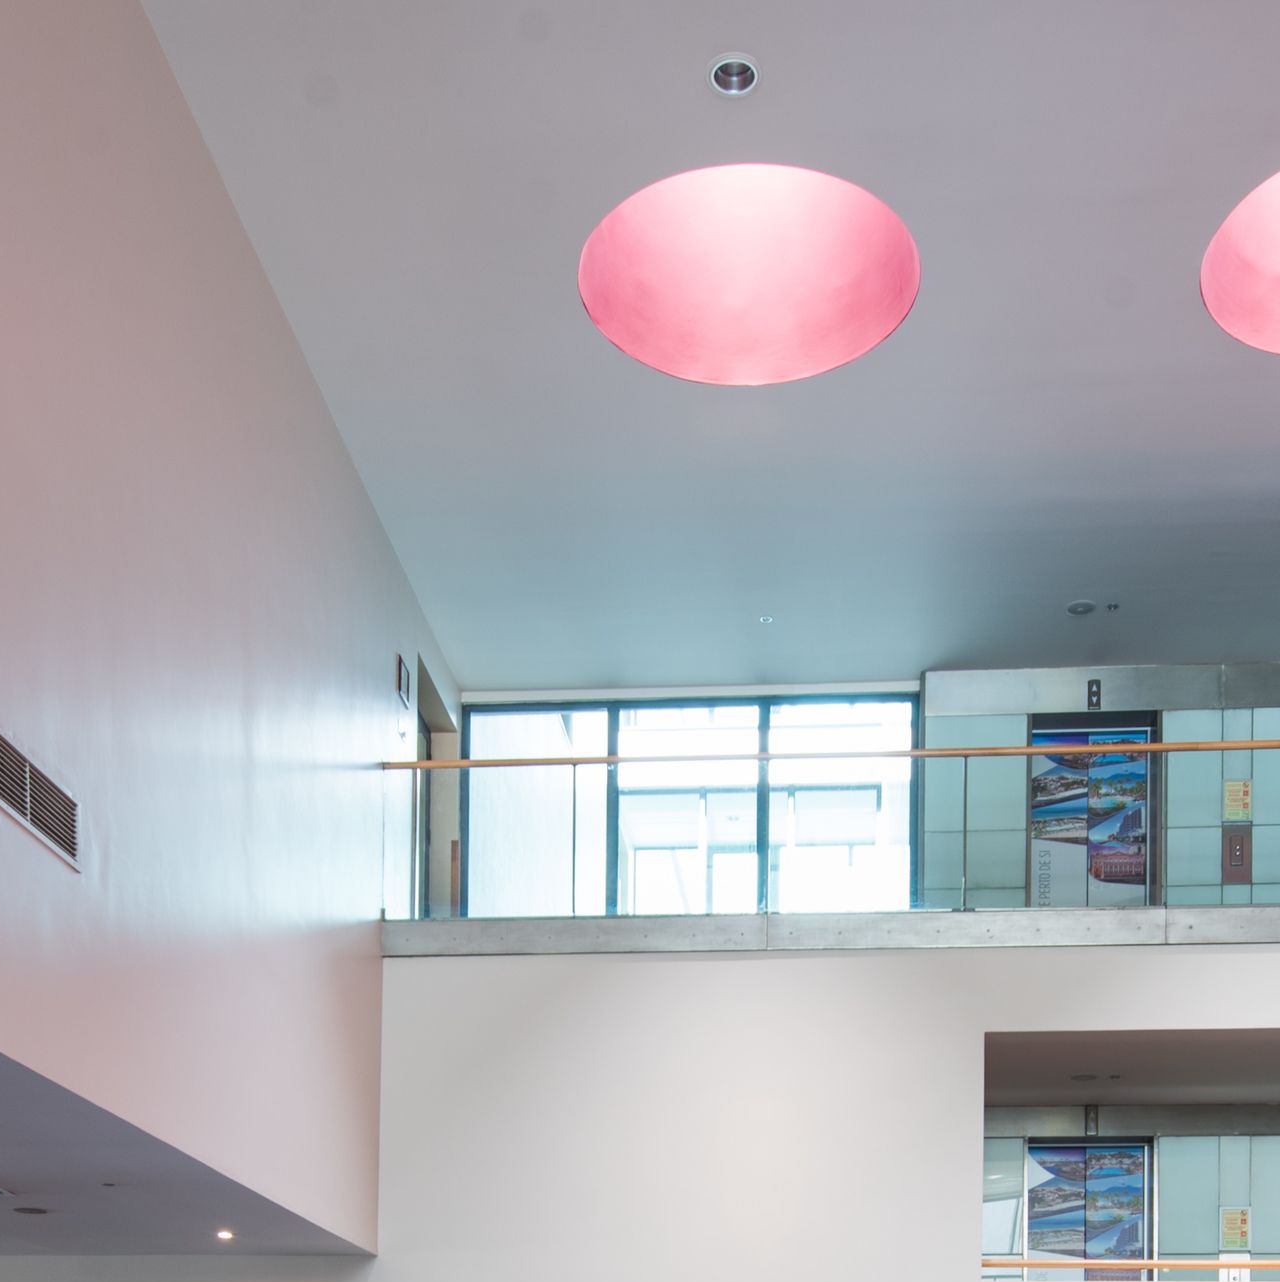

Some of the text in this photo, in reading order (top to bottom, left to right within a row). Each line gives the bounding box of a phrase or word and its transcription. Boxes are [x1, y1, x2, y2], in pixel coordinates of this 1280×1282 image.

[1038, 850, 1051, 858] SI
[1038, 859, 1051, 871] DE
[1038, 872, 1051, 899] PERTO
